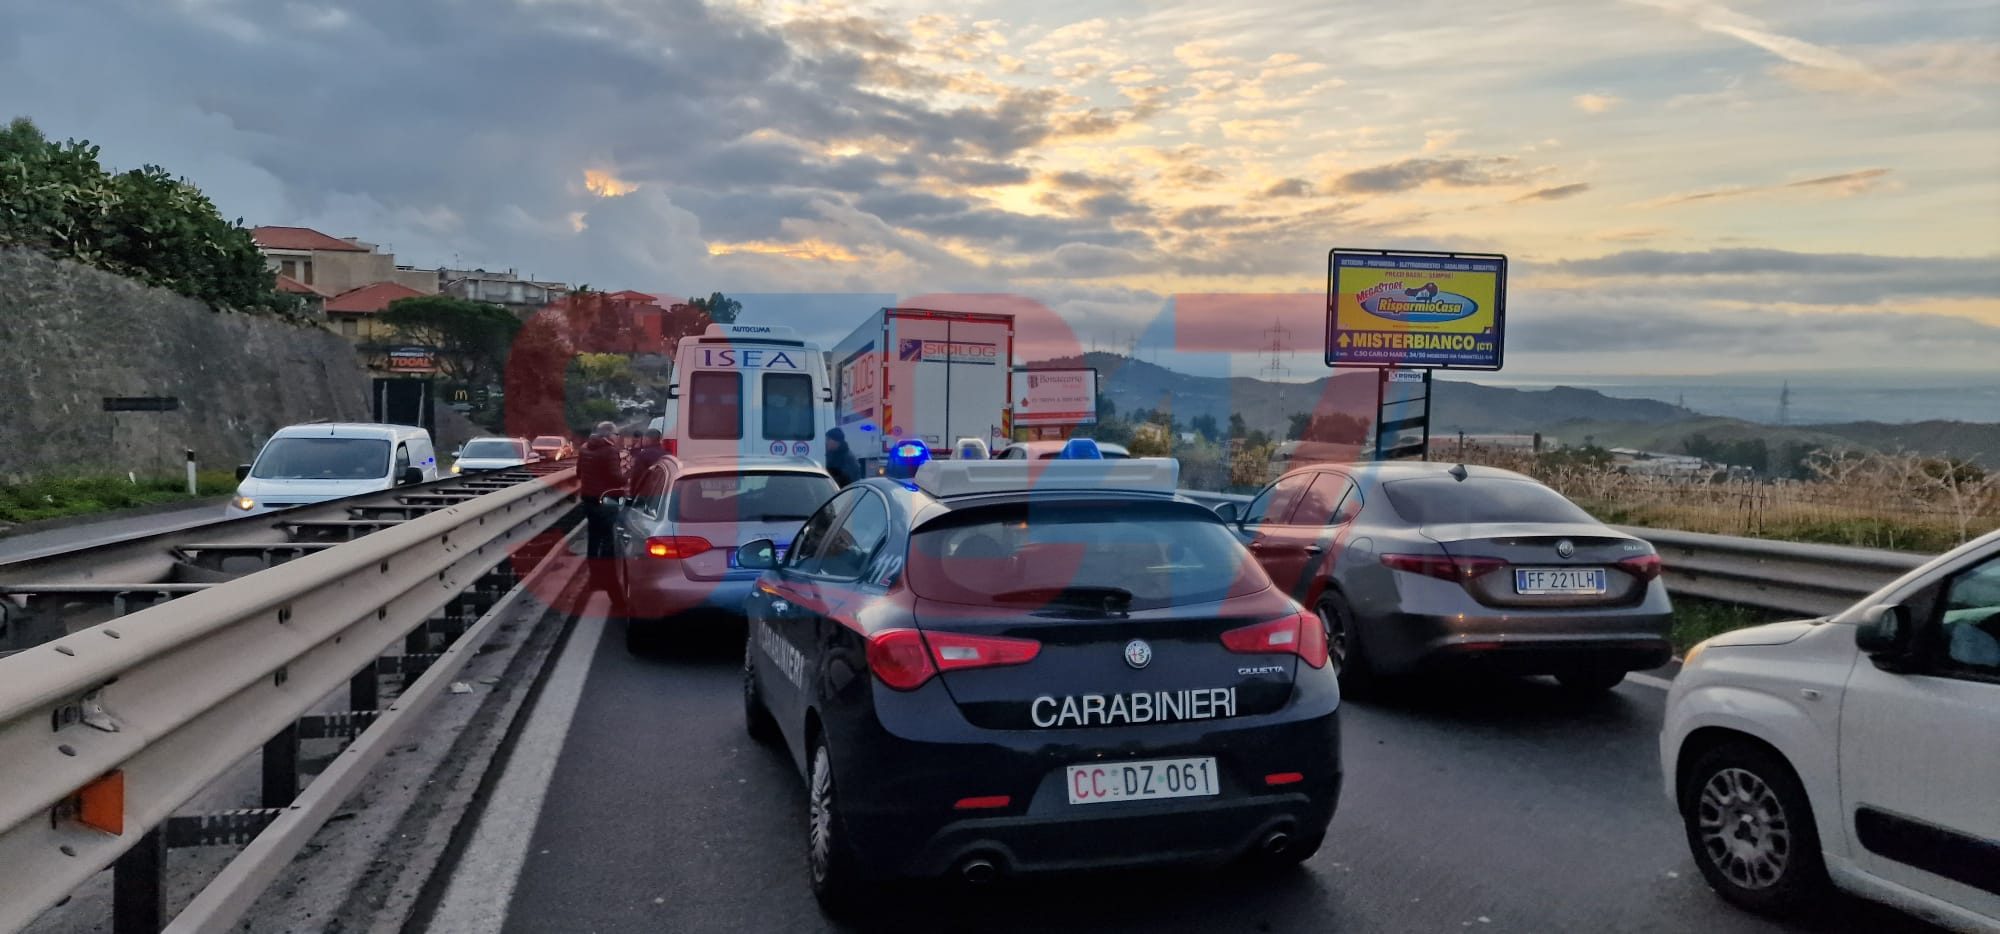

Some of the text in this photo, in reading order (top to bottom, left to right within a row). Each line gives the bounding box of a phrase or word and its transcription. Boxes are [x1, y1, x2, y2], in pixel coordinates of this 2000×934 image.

[1379, 298, 1462, 314] RisparmioCasa
[732, 325, 771, 333] AUTOCLIMA
[923, 343, 996, 357] SICILOG
[1353, 332, 1493, 353] MISTERBIANCO (CT)
[704, 350, 797, 368] ISEA
[867, 553, 903, 586] 112
[1528, 572, 1595, 588] FF 221LH
[1238, 666, 1285, 675] GIULIETTA
[1031, 687, 1237, 728] CARABINIERI
[1074, 762, 1210, 799] CC DZ 061
